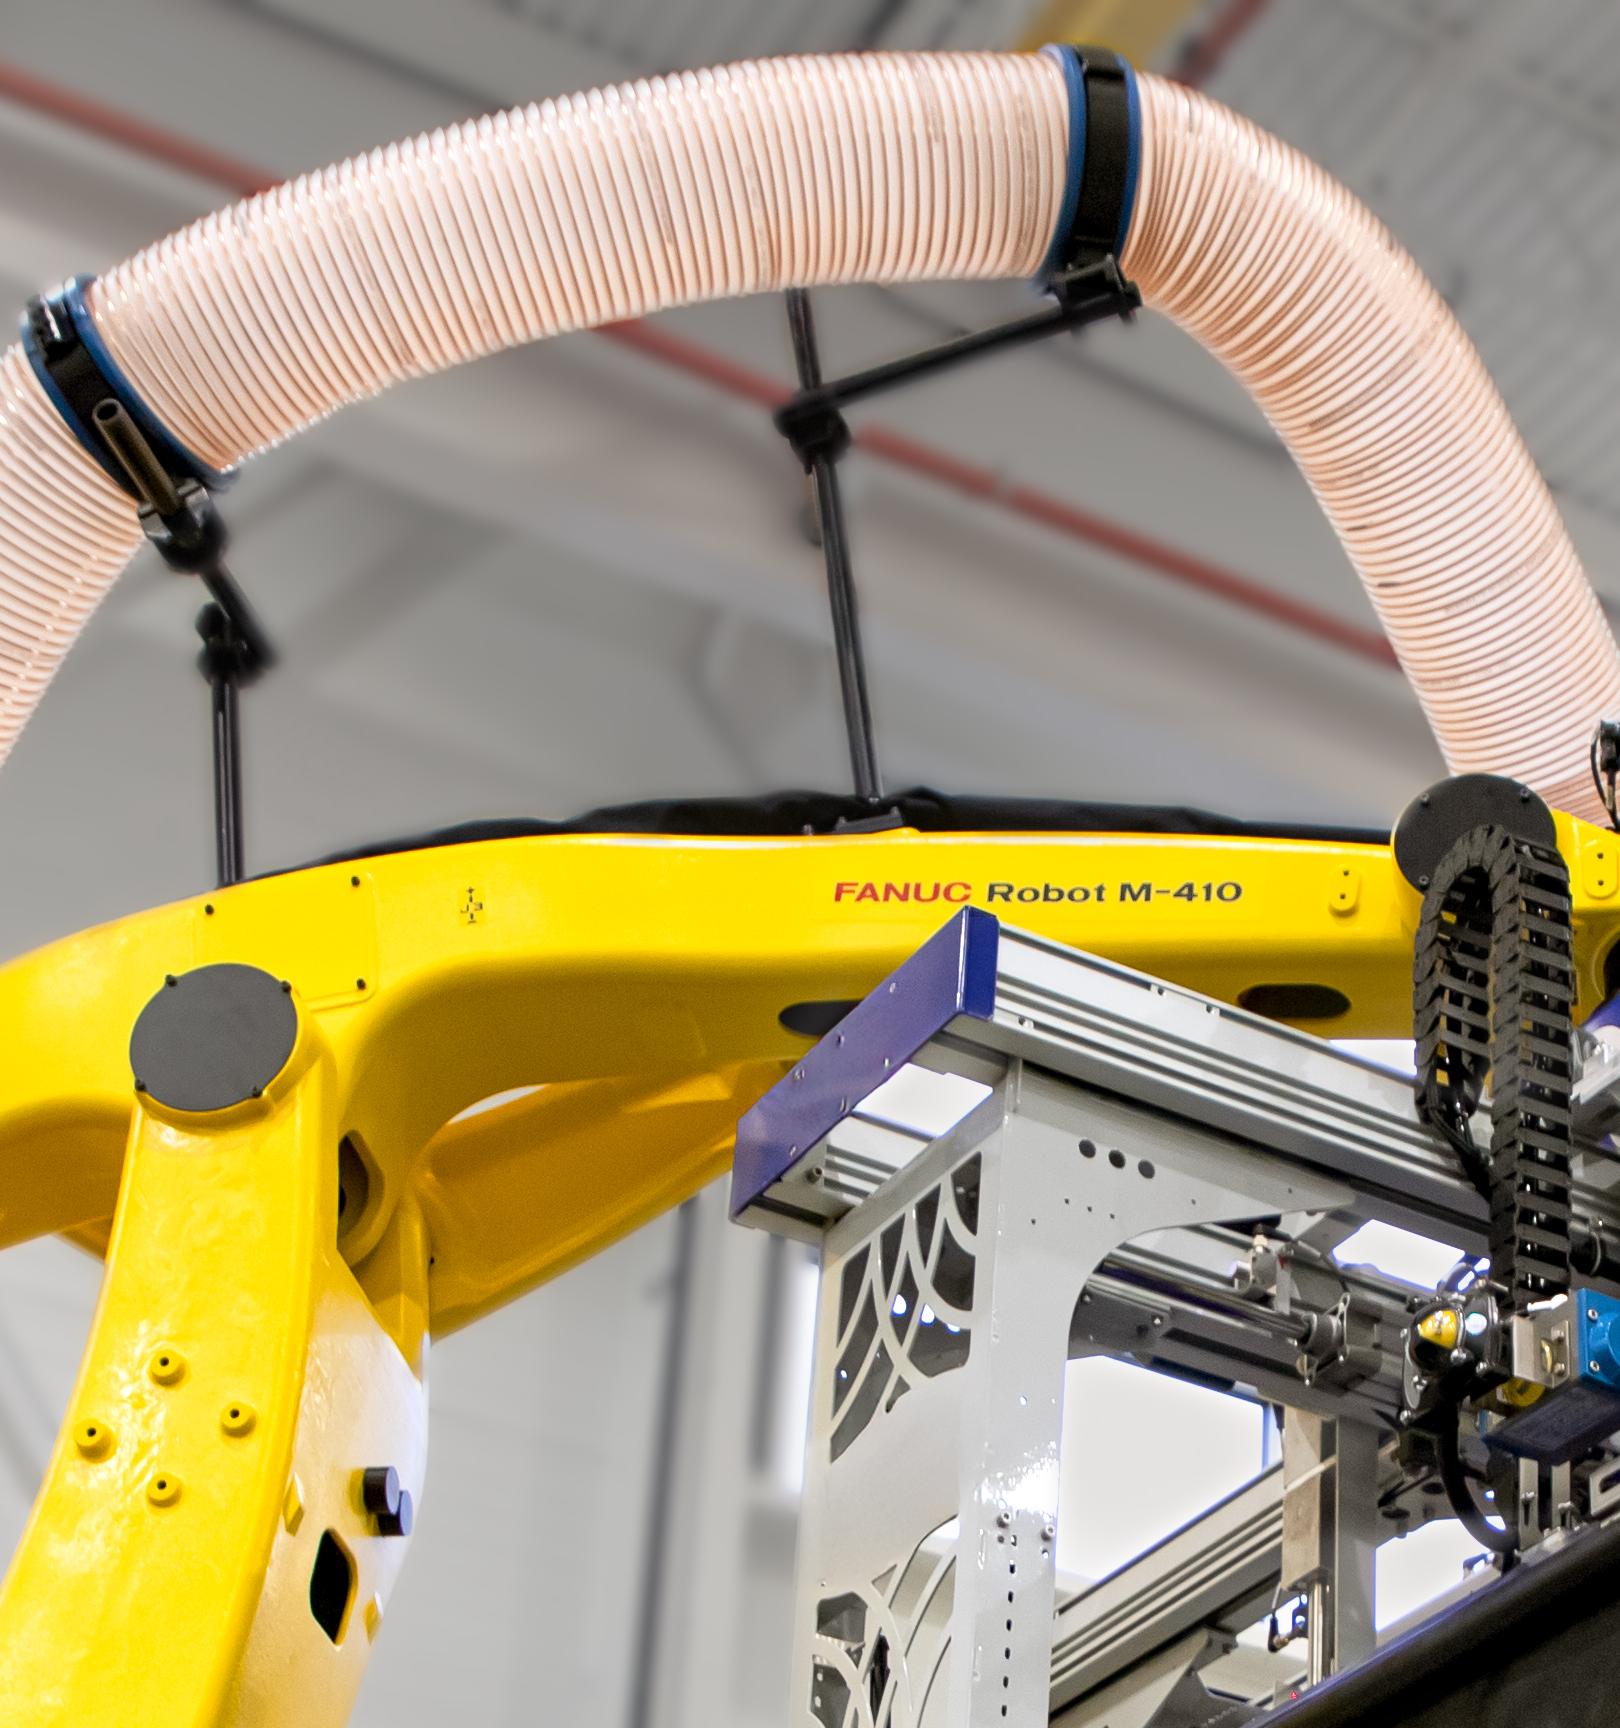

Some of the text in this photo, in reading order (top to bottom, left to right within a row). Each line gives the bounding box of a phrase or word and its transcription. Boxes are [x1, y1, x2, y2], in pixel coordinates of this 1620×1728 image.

[834, 881, 1243, 903] FANUC Robot M-410
